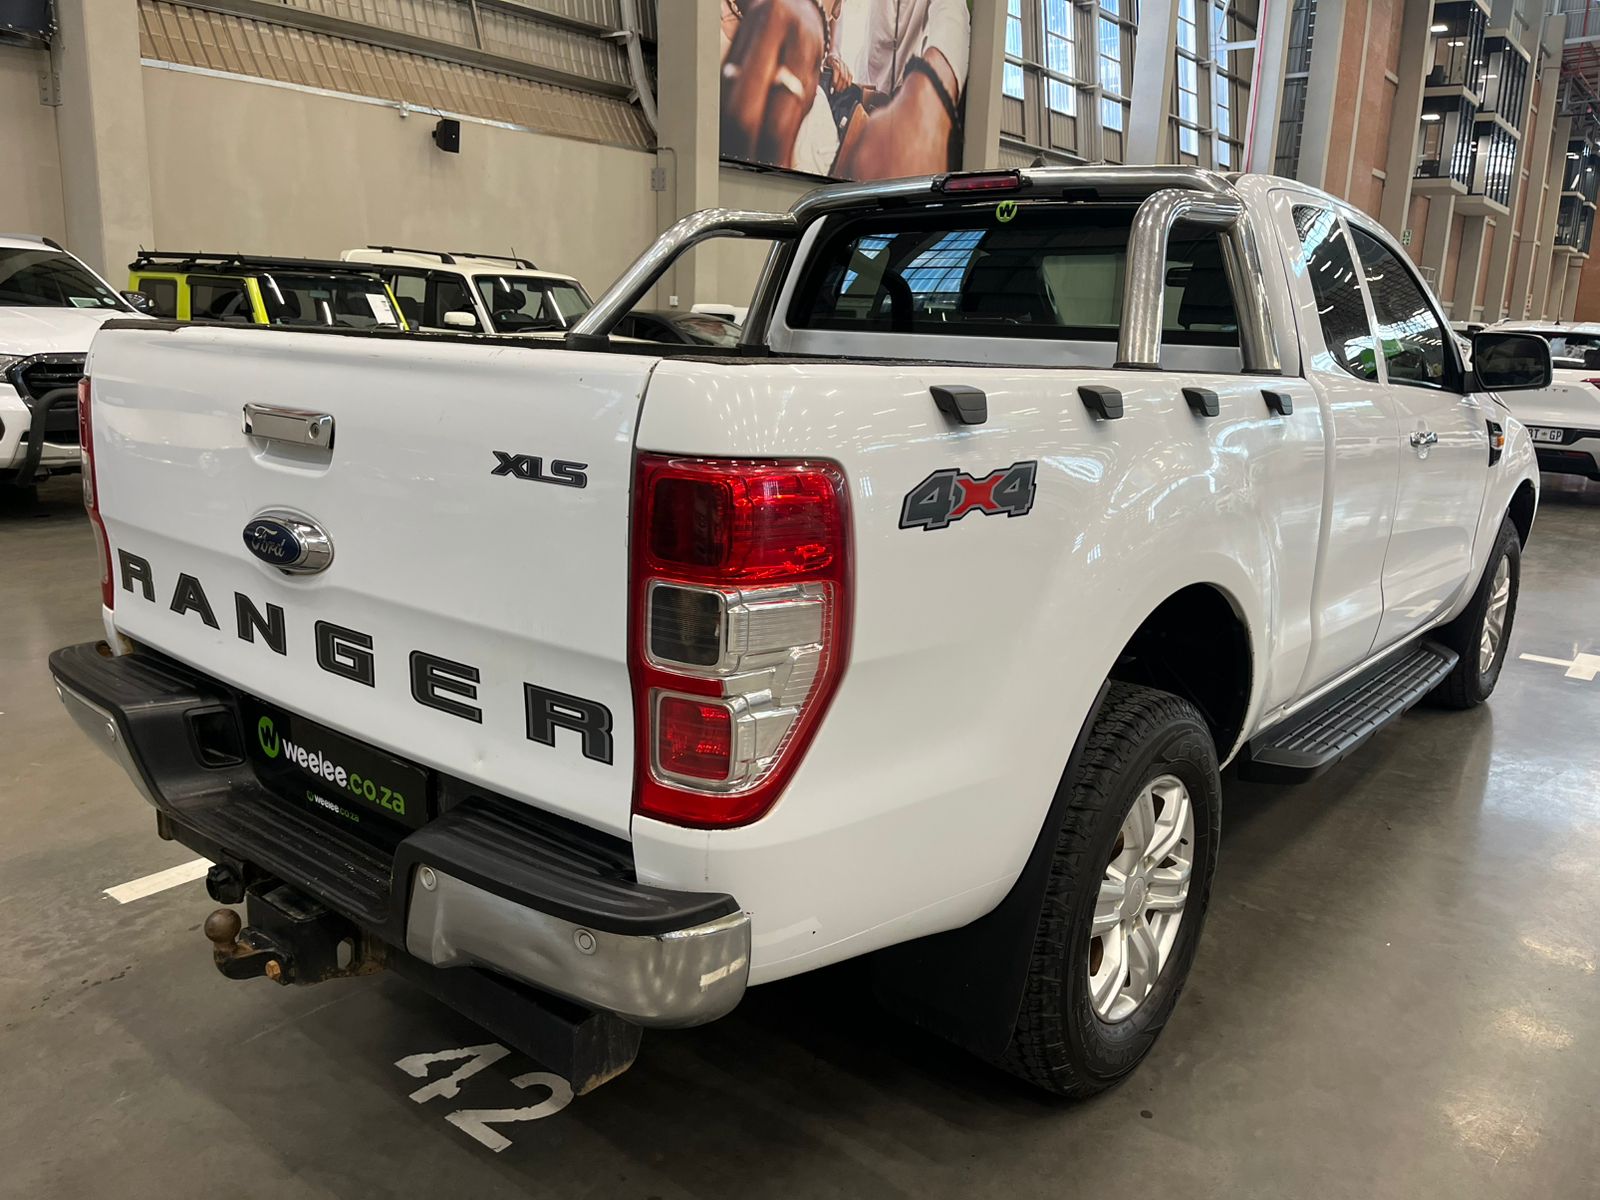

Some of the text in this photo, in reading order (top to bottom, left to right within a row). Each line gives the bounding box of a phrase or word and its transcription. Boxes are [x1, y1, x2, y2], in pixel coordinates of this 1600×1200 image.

[1549, 430, 1562, 441] GP
[491, 451, 588, 489] XLS
[251, 526, 286, 557] Ford
[117, 548, 615, 766] RANGER
[282, 738, 405, 816] weelee.co.za
[314, 795, 360, 823] weelee.co.za
[394, 1043, 574, 1152] 42
